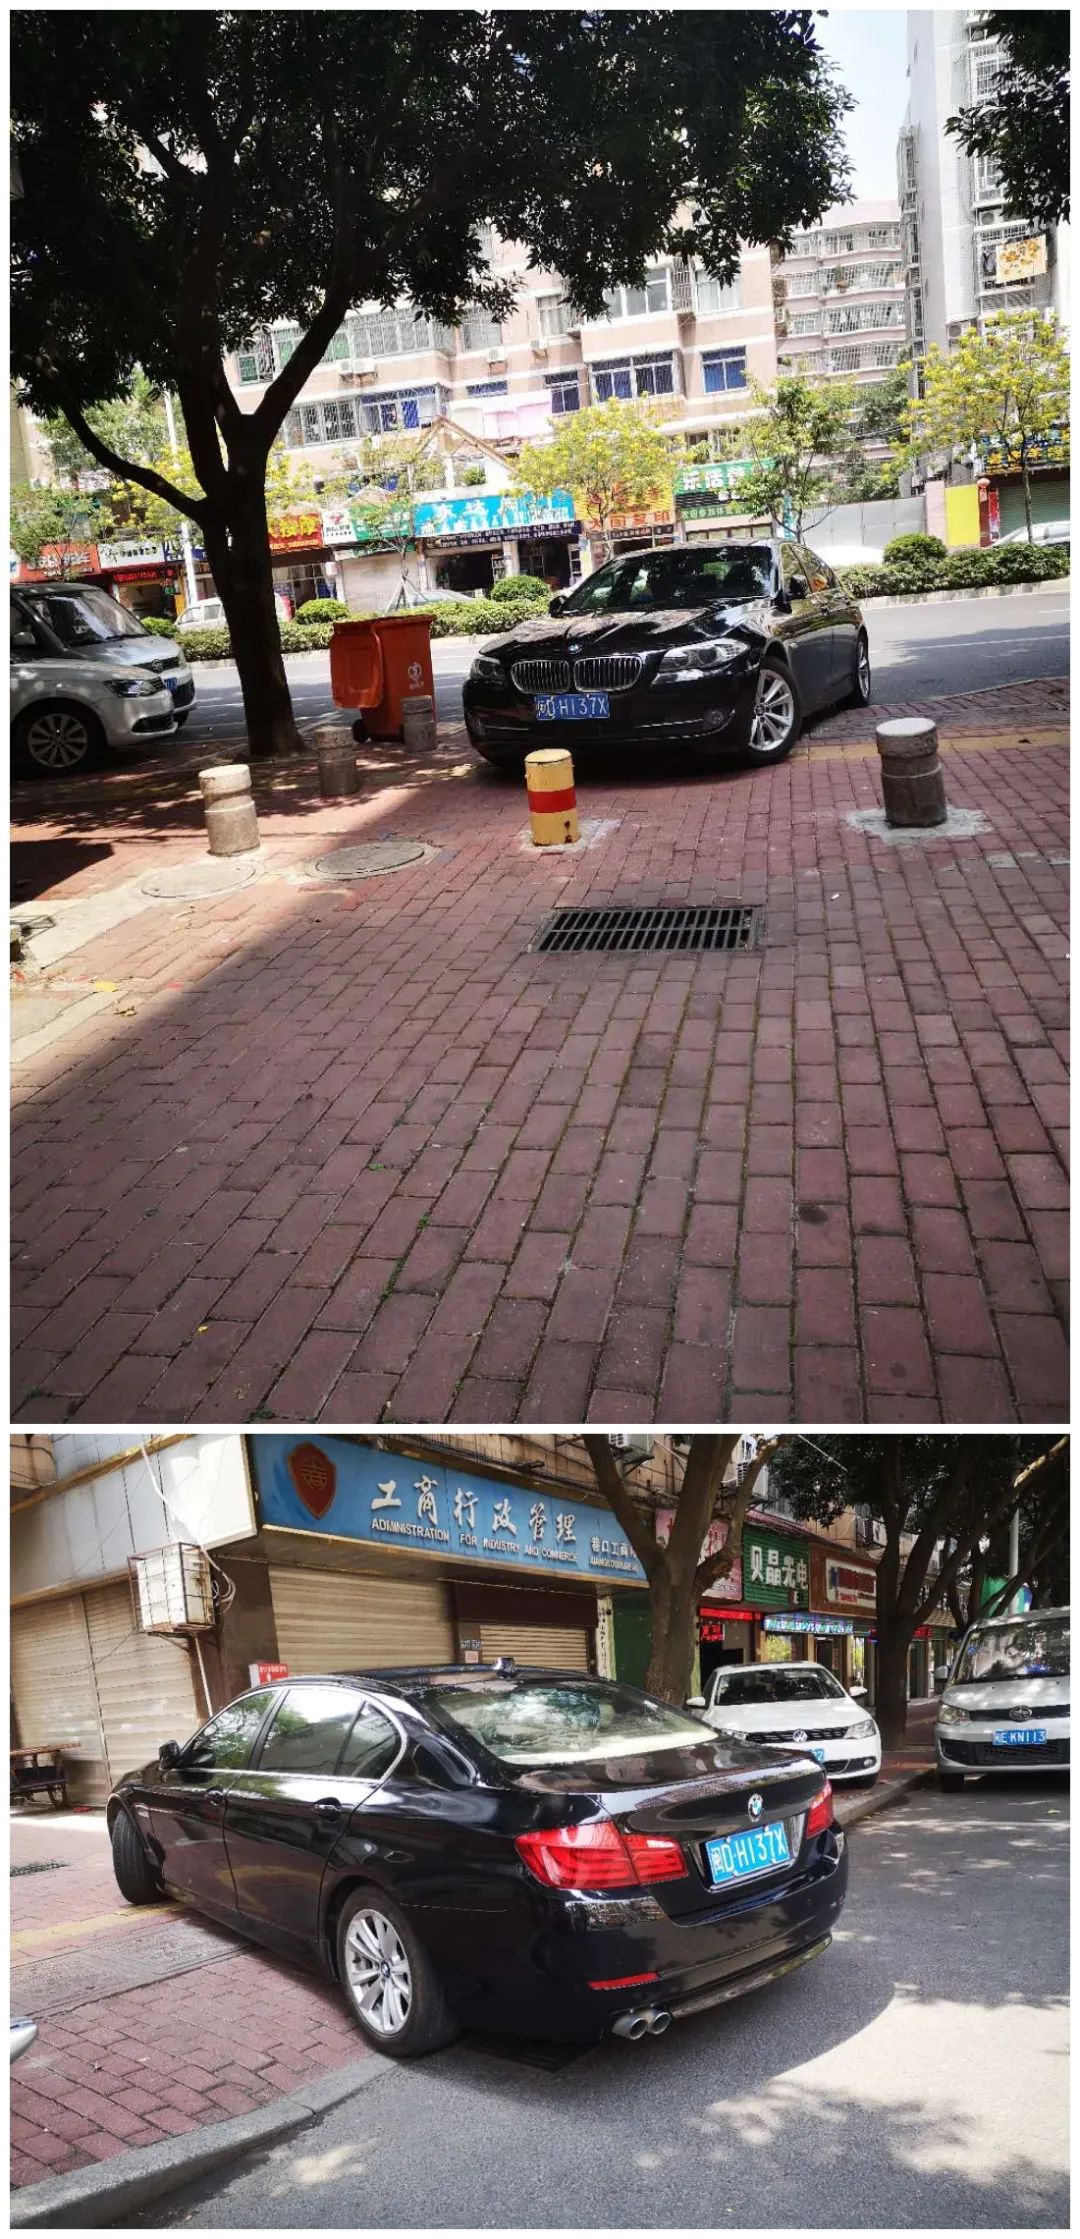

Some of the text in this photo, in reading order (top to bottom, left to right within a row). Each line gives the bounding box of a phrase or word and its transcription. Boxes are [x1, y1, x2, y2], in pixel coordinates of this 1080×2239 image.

[371, 1475, 577, 1541] 工商行政管理
[371, 1518, 450, 1542] ADMINISTRATION
[460, 1533, 478, 1546] FOR
[483, 1538, 520, 1552] INDUSTRY
[524, 1545, 539, 1556] AND
[751, 1545, 809, 1590] 贝晶光电
